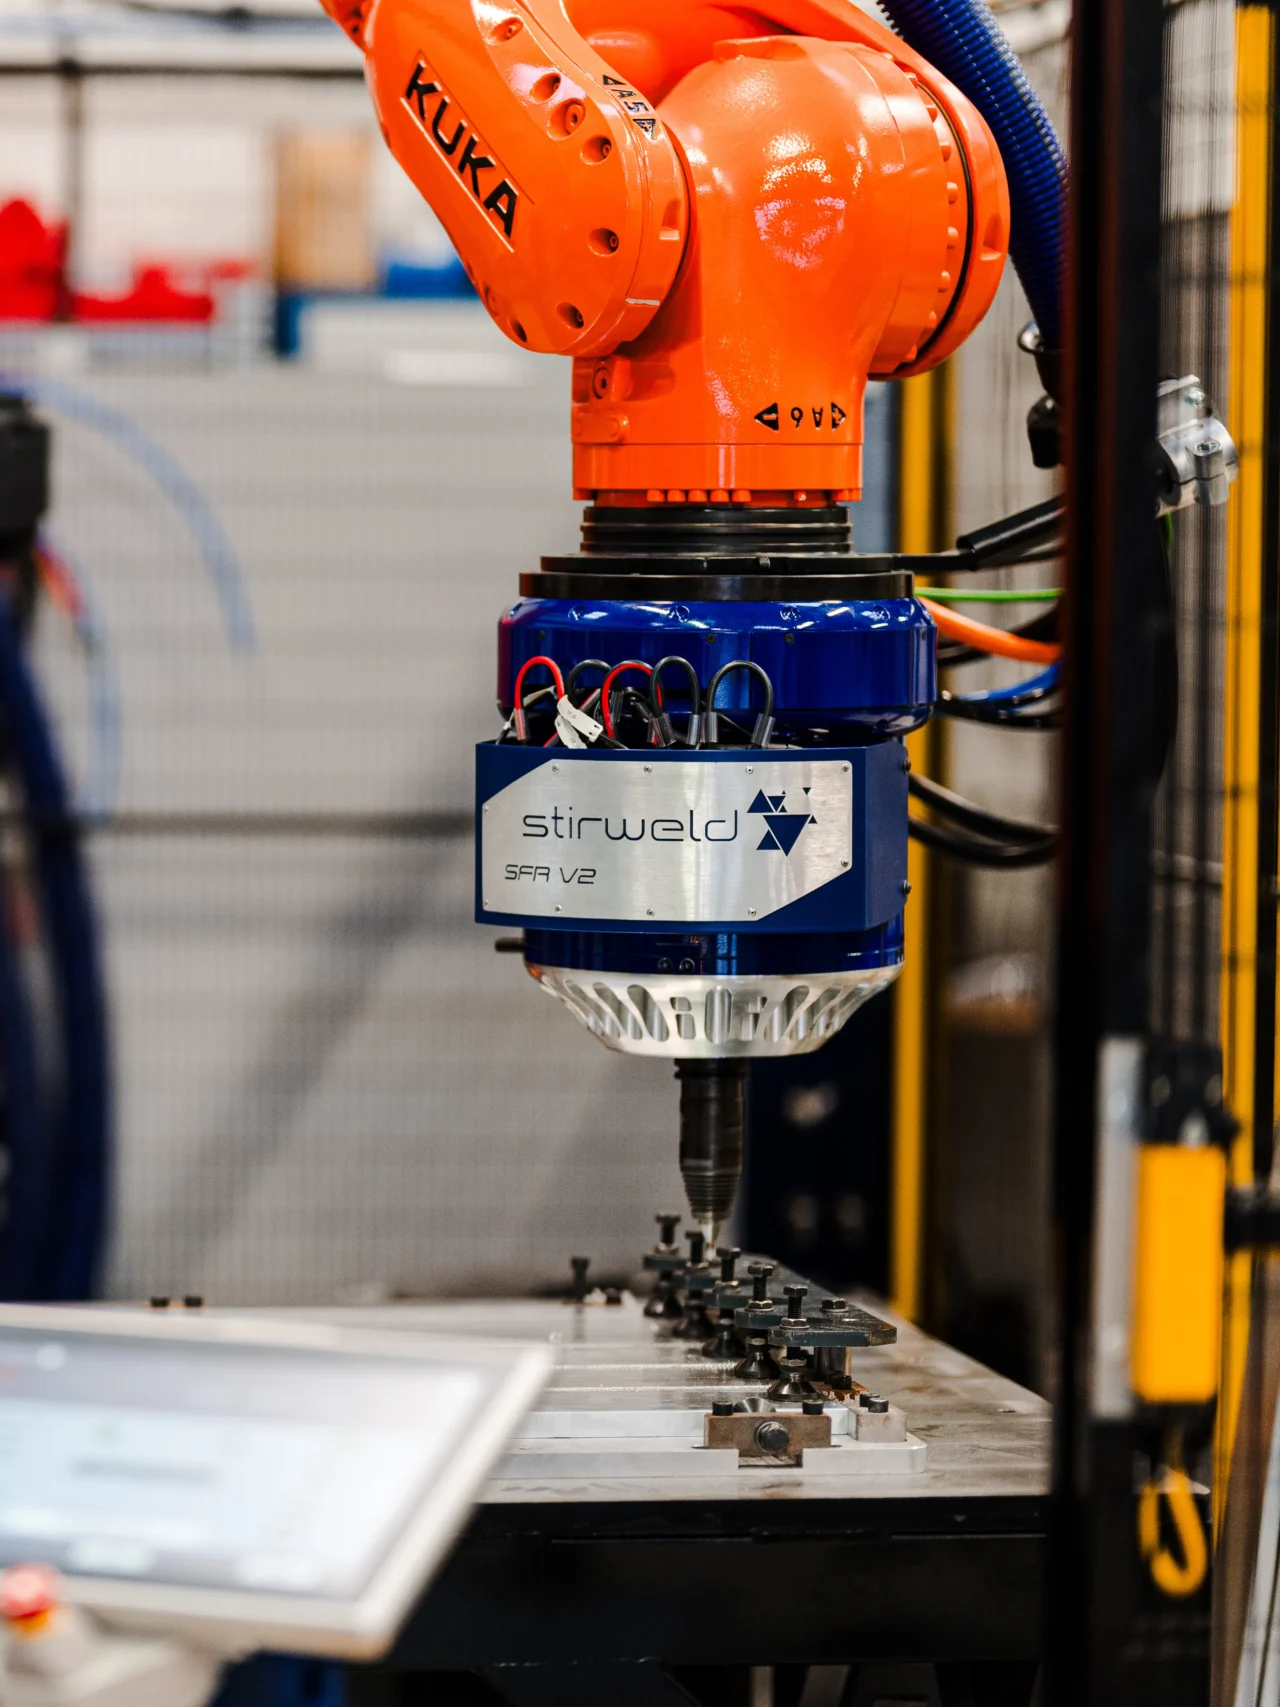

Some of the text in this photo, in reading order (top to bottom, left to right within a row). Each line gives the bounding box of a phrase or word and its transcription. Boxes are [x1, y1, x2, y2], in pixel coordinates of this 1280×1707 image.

[406, 62, 518, 239] KUKA
[522, 806, 738, 842] stirweld
[559, 867, 597, 884] V2
